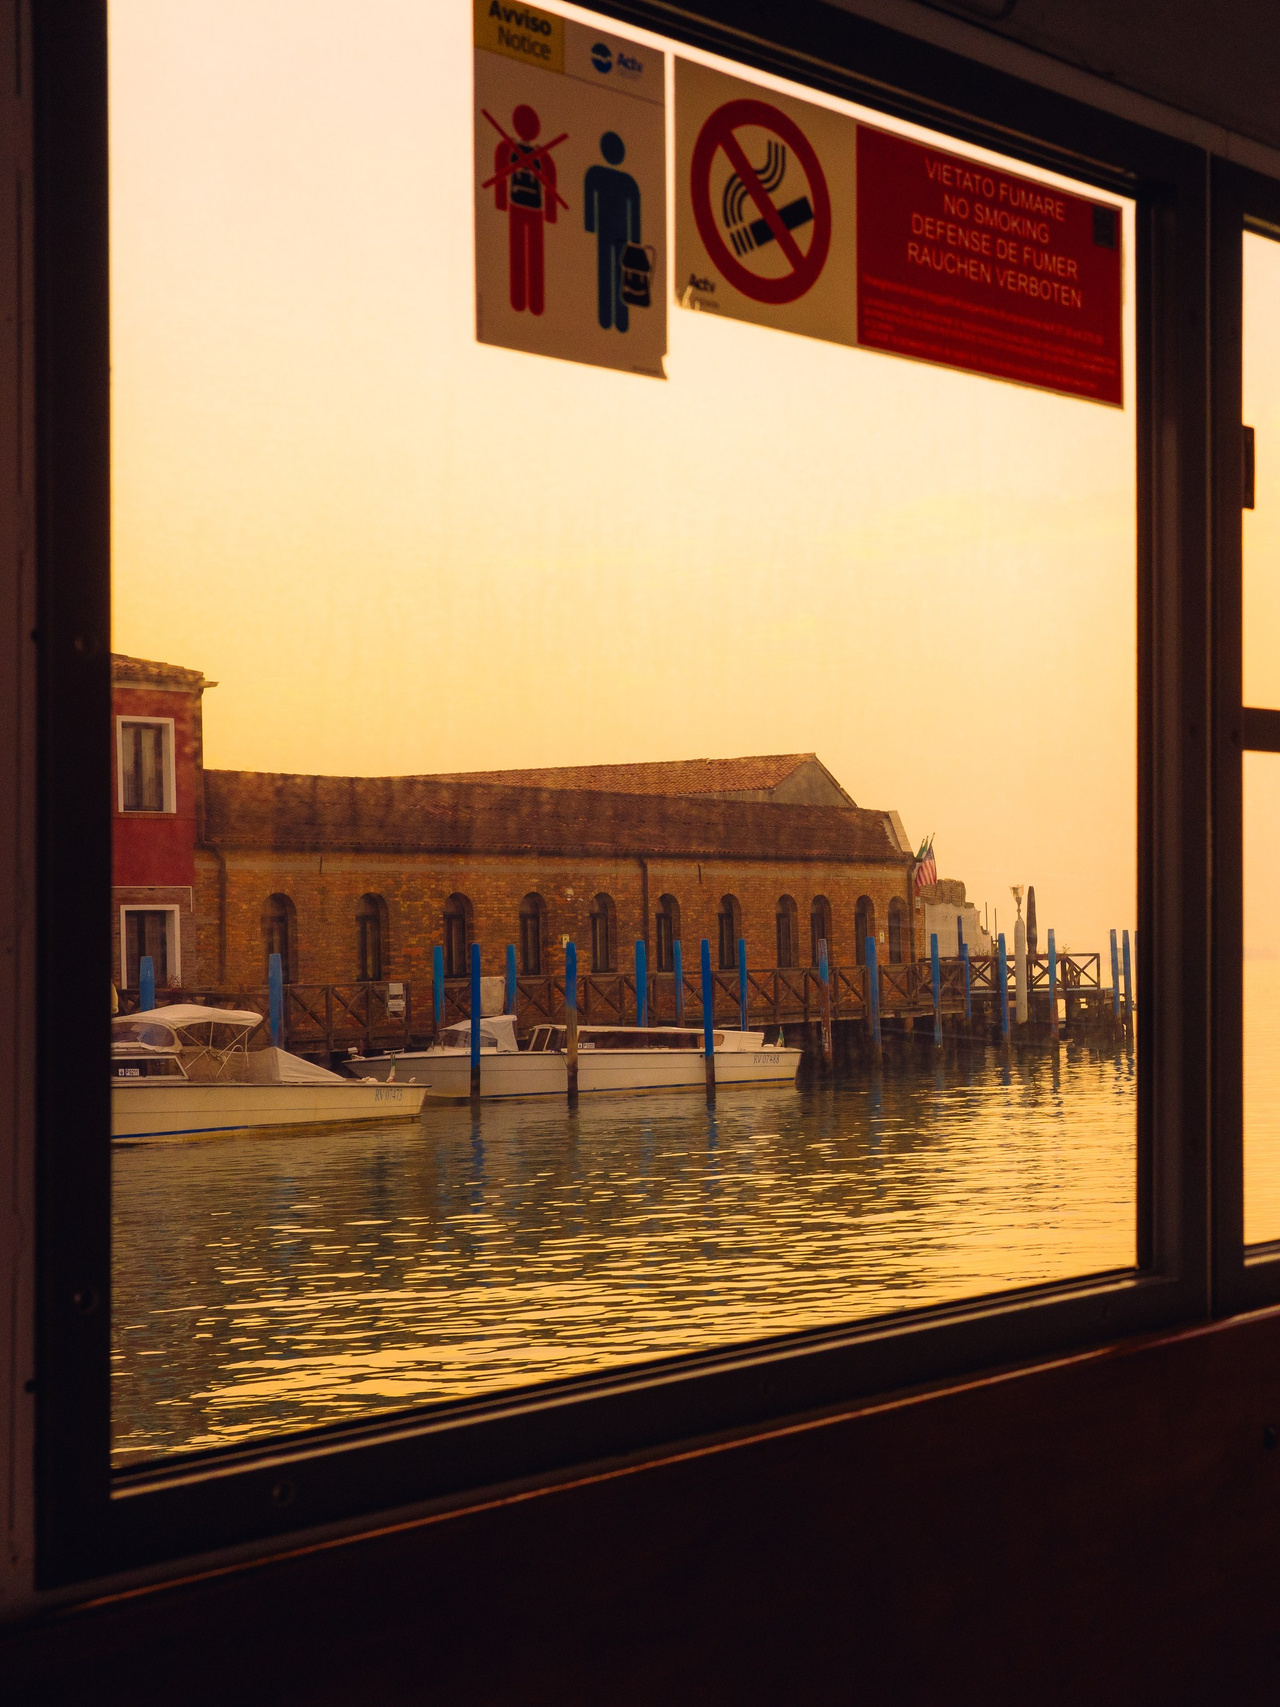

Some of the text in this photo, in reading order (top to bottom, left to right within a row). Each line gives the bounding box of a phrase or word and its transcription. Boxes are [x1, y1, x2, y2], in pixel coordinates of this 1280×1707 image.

[489, 0, 552, 37] Avviso
[497, 25, 552, 61] Notice
[925, 157, 1065, 222] VIETATO FUMARE
[943, 193, 1050, 244] NO SMOKING
[907, 241, 1083, 309] RAUCHEN VERBOTEN
[911, 212, 1079, 280] DEFENSE DE FUMER
